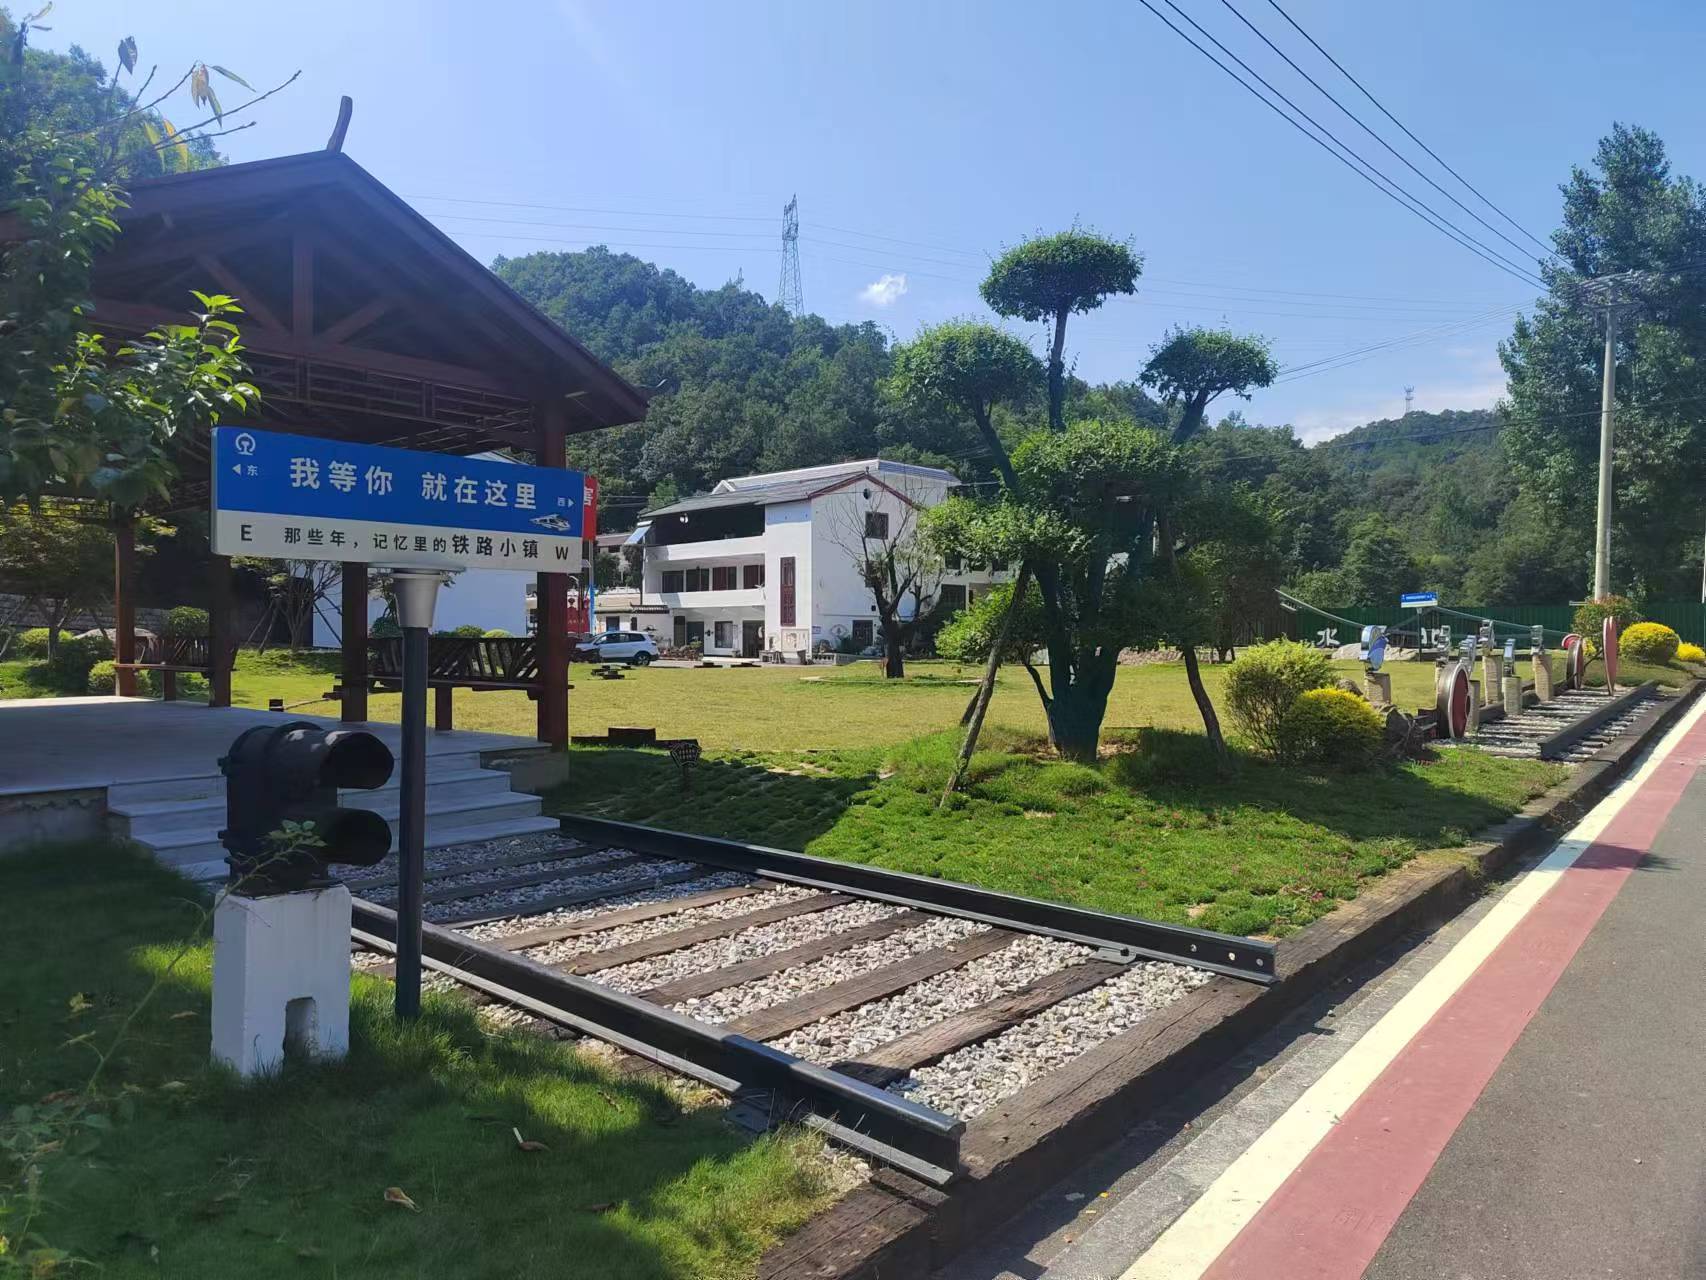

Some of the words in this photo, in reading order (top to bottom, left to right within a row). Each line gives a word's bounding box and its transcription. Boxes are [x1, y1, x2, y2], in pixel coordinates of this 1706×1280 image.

[247, 464, 259, 477] 东
[289, 456, 393, 496] 我等你
[421, 472, 537, 510] 就在这里
[240, 524, 253, 542] E
[284, 526, 539, 559] 那些年，记忆里的铁路小镇
[555, 545, 569, 561] W
